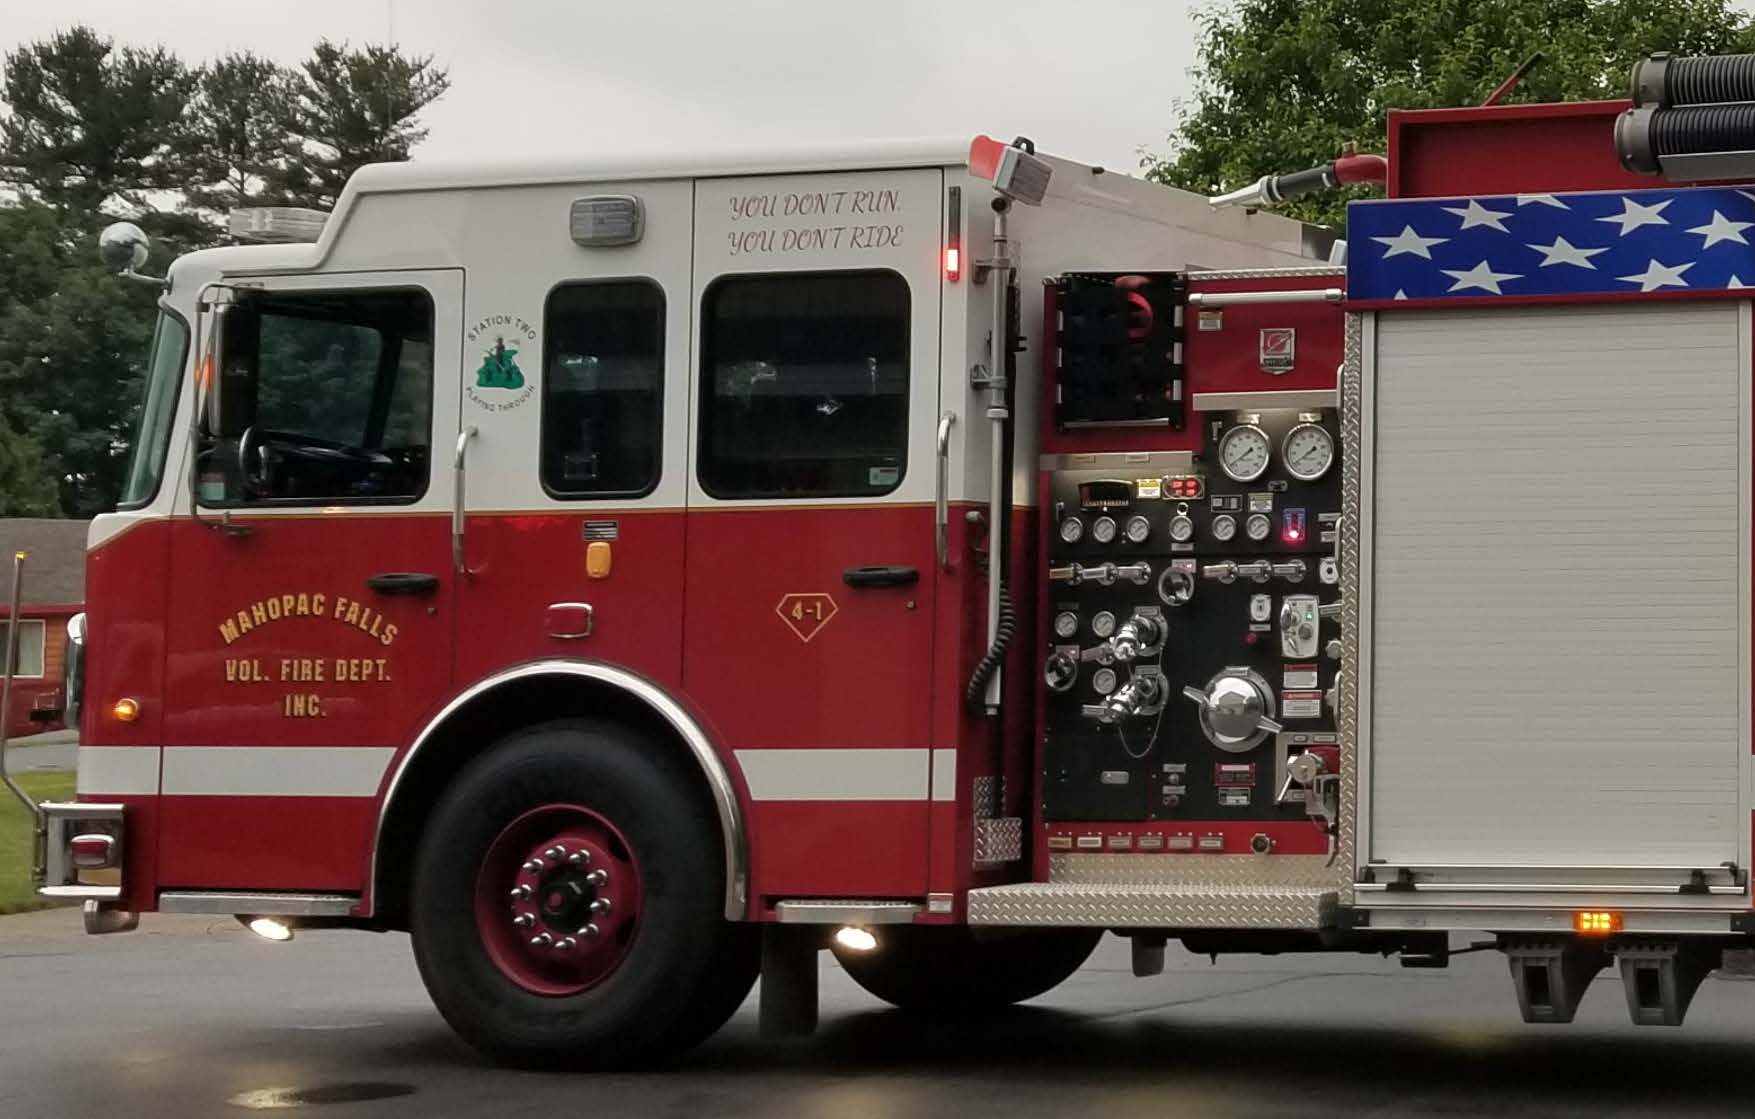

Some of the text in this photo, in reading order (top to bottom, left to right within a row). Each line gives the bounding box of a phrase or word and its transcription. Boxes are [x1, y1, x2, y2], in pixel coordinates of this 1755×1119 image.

[729, 194, 777, 220] YOU
[728, 229, 776, 256] YOU
[850, 225, 905, 249] RIDE
[467, 315, 537, 342] STATION TWO
[497, 384, 536, 412] THROUGH
[218, 592, 399, 646] MAHOPAC FALLS
[791, 600, 823, 621] 4-1
[225, 659, 392, 682] VOL. FIRE DEPT.
[284, 694, 328, 718] INC.
